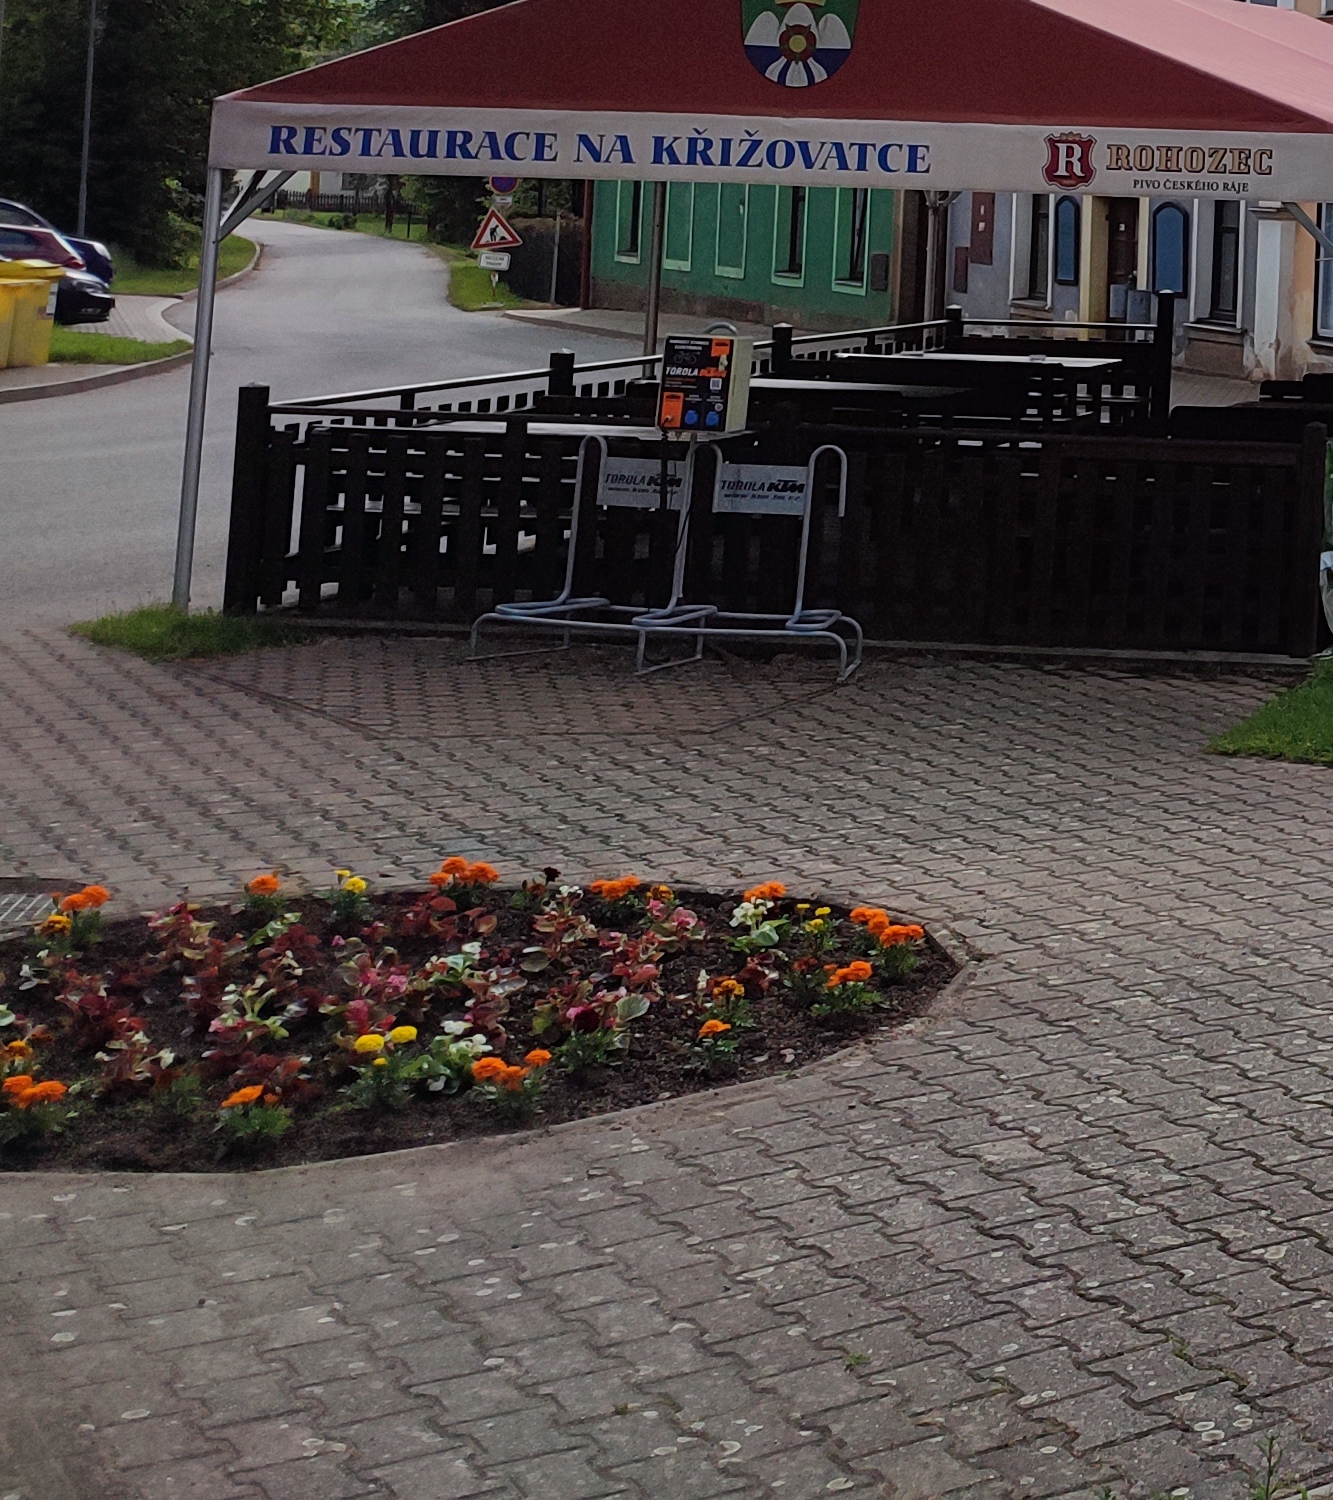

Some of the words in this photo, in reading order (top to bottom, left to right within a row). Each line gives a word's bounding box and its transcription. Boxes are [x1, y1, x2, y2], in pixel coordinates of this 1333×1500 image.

[267, 124, 558, 162] RESTAURACE
[573, 133, 636, 164] NA
[650, 127, 931, 174] KŘIŽOVATCE
[1053, 142, 1086, 177] R
[1106, 143, 1273, 175] ROHOZEC
[1132, 179, 1161, 190] PIVO
[1163, 178, 1219, 192] ČESKÉHO
[1222, 180, 1250, 194] RÁJE
[665, 366, 699, 376] TOROLA
[605, 473, 647, 486] TOROLA
[721, 479, 766, 492] TOROLA
[766, 479, 805, 494] KTM
